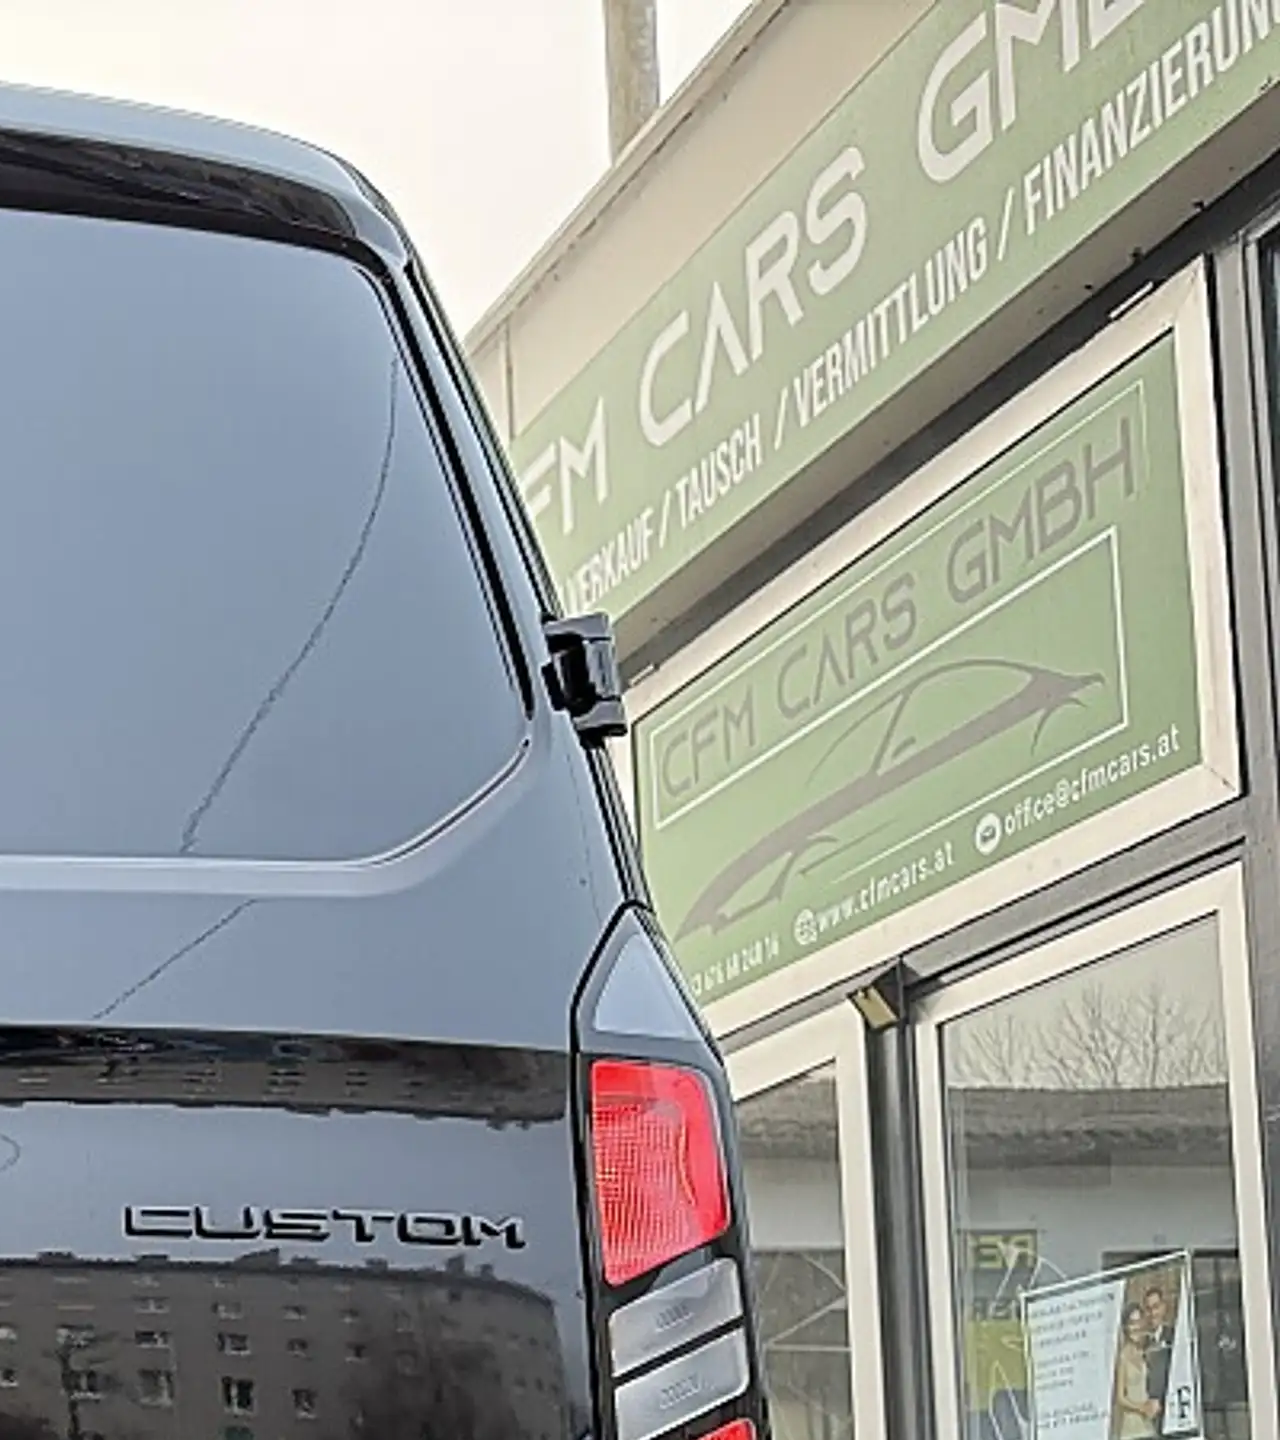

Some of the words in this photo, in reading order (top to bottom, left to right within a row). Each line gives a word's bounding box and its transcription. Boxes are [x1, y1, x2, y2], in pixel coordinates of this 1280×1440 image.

[640, 147, 867, 447] CARS
[917, 0, 1141, 182] GM
[676, 412, 762, 529] TAUSCH
[793, 216, 987, 429] VERMITTLUNG
[1024, 0, 1280, 236] FINANZIERUN
[661, 686, 757, 798] CFM
[777, 572, 917, 720] CARS
[946, 416, 1135, 603] GMBH
[816, 841, 956, 933] www.cfmcars.at
[121, 1205, 527, 1249] CUSTOM
